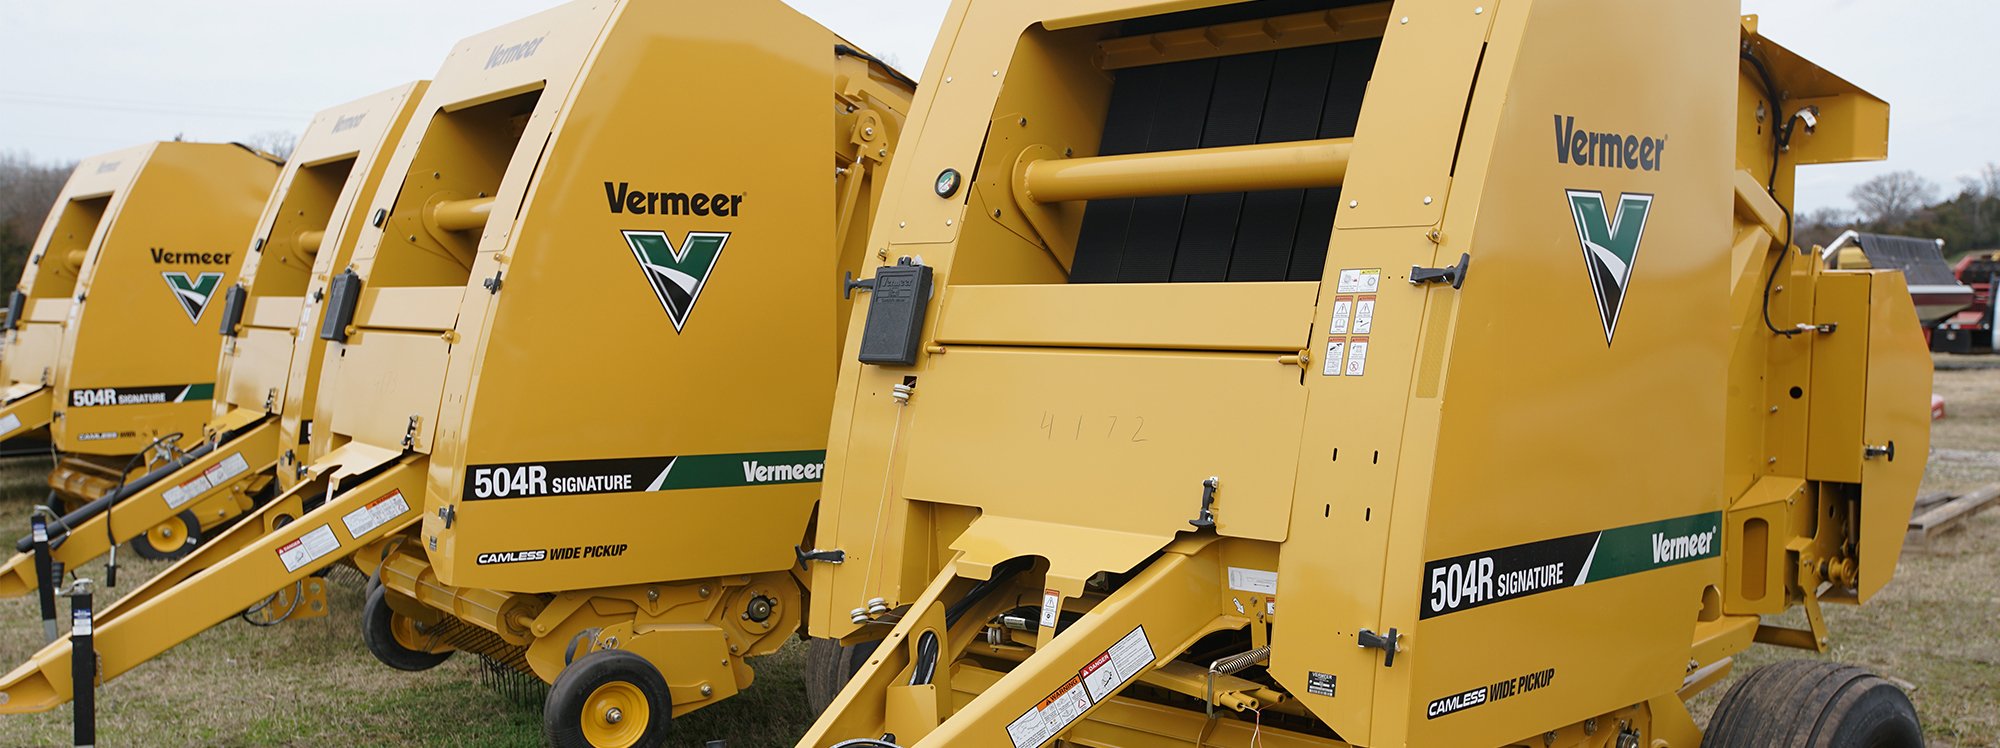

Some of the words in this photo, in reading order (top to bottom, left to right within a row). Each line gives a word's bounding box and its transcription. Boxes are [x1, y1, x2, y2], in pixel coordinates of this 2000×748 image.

[484, 36, 545, 70] Vermeer
[1554, 114, 1664, 171] Vermeer
[604, 181, 742, 216] Vermeer
[150, 247, 231, 264] Vermeer
[73, 388, 118, 407] 504R
[118, 392, 166, 405] SIGNATURE
[474, 465, 548, 498] 504R
[552, 474, 632, 493] SIGNATURE
[742, 460, 824, 482] Vermeer
[478, 550, 545, 564] CAMLESS
[550, 546, 581, 560] WIDE
[583, 543, 628, 558] PICKUP
[1431, 556, 1495, 613] 504R
[1497, 562, 1564, 597] SIGNATURE
[1651, 531, 1713, 564] Vermeer
[1088, 654, 1110, 672] DANGER
[1050, 678, 1078, 701] WARNING
[1429, 688, 1486, 717] CAMLESS
[1489, 678, 1517, 702] WIDE
[1517, 667, 1555, 695] PICKUP
